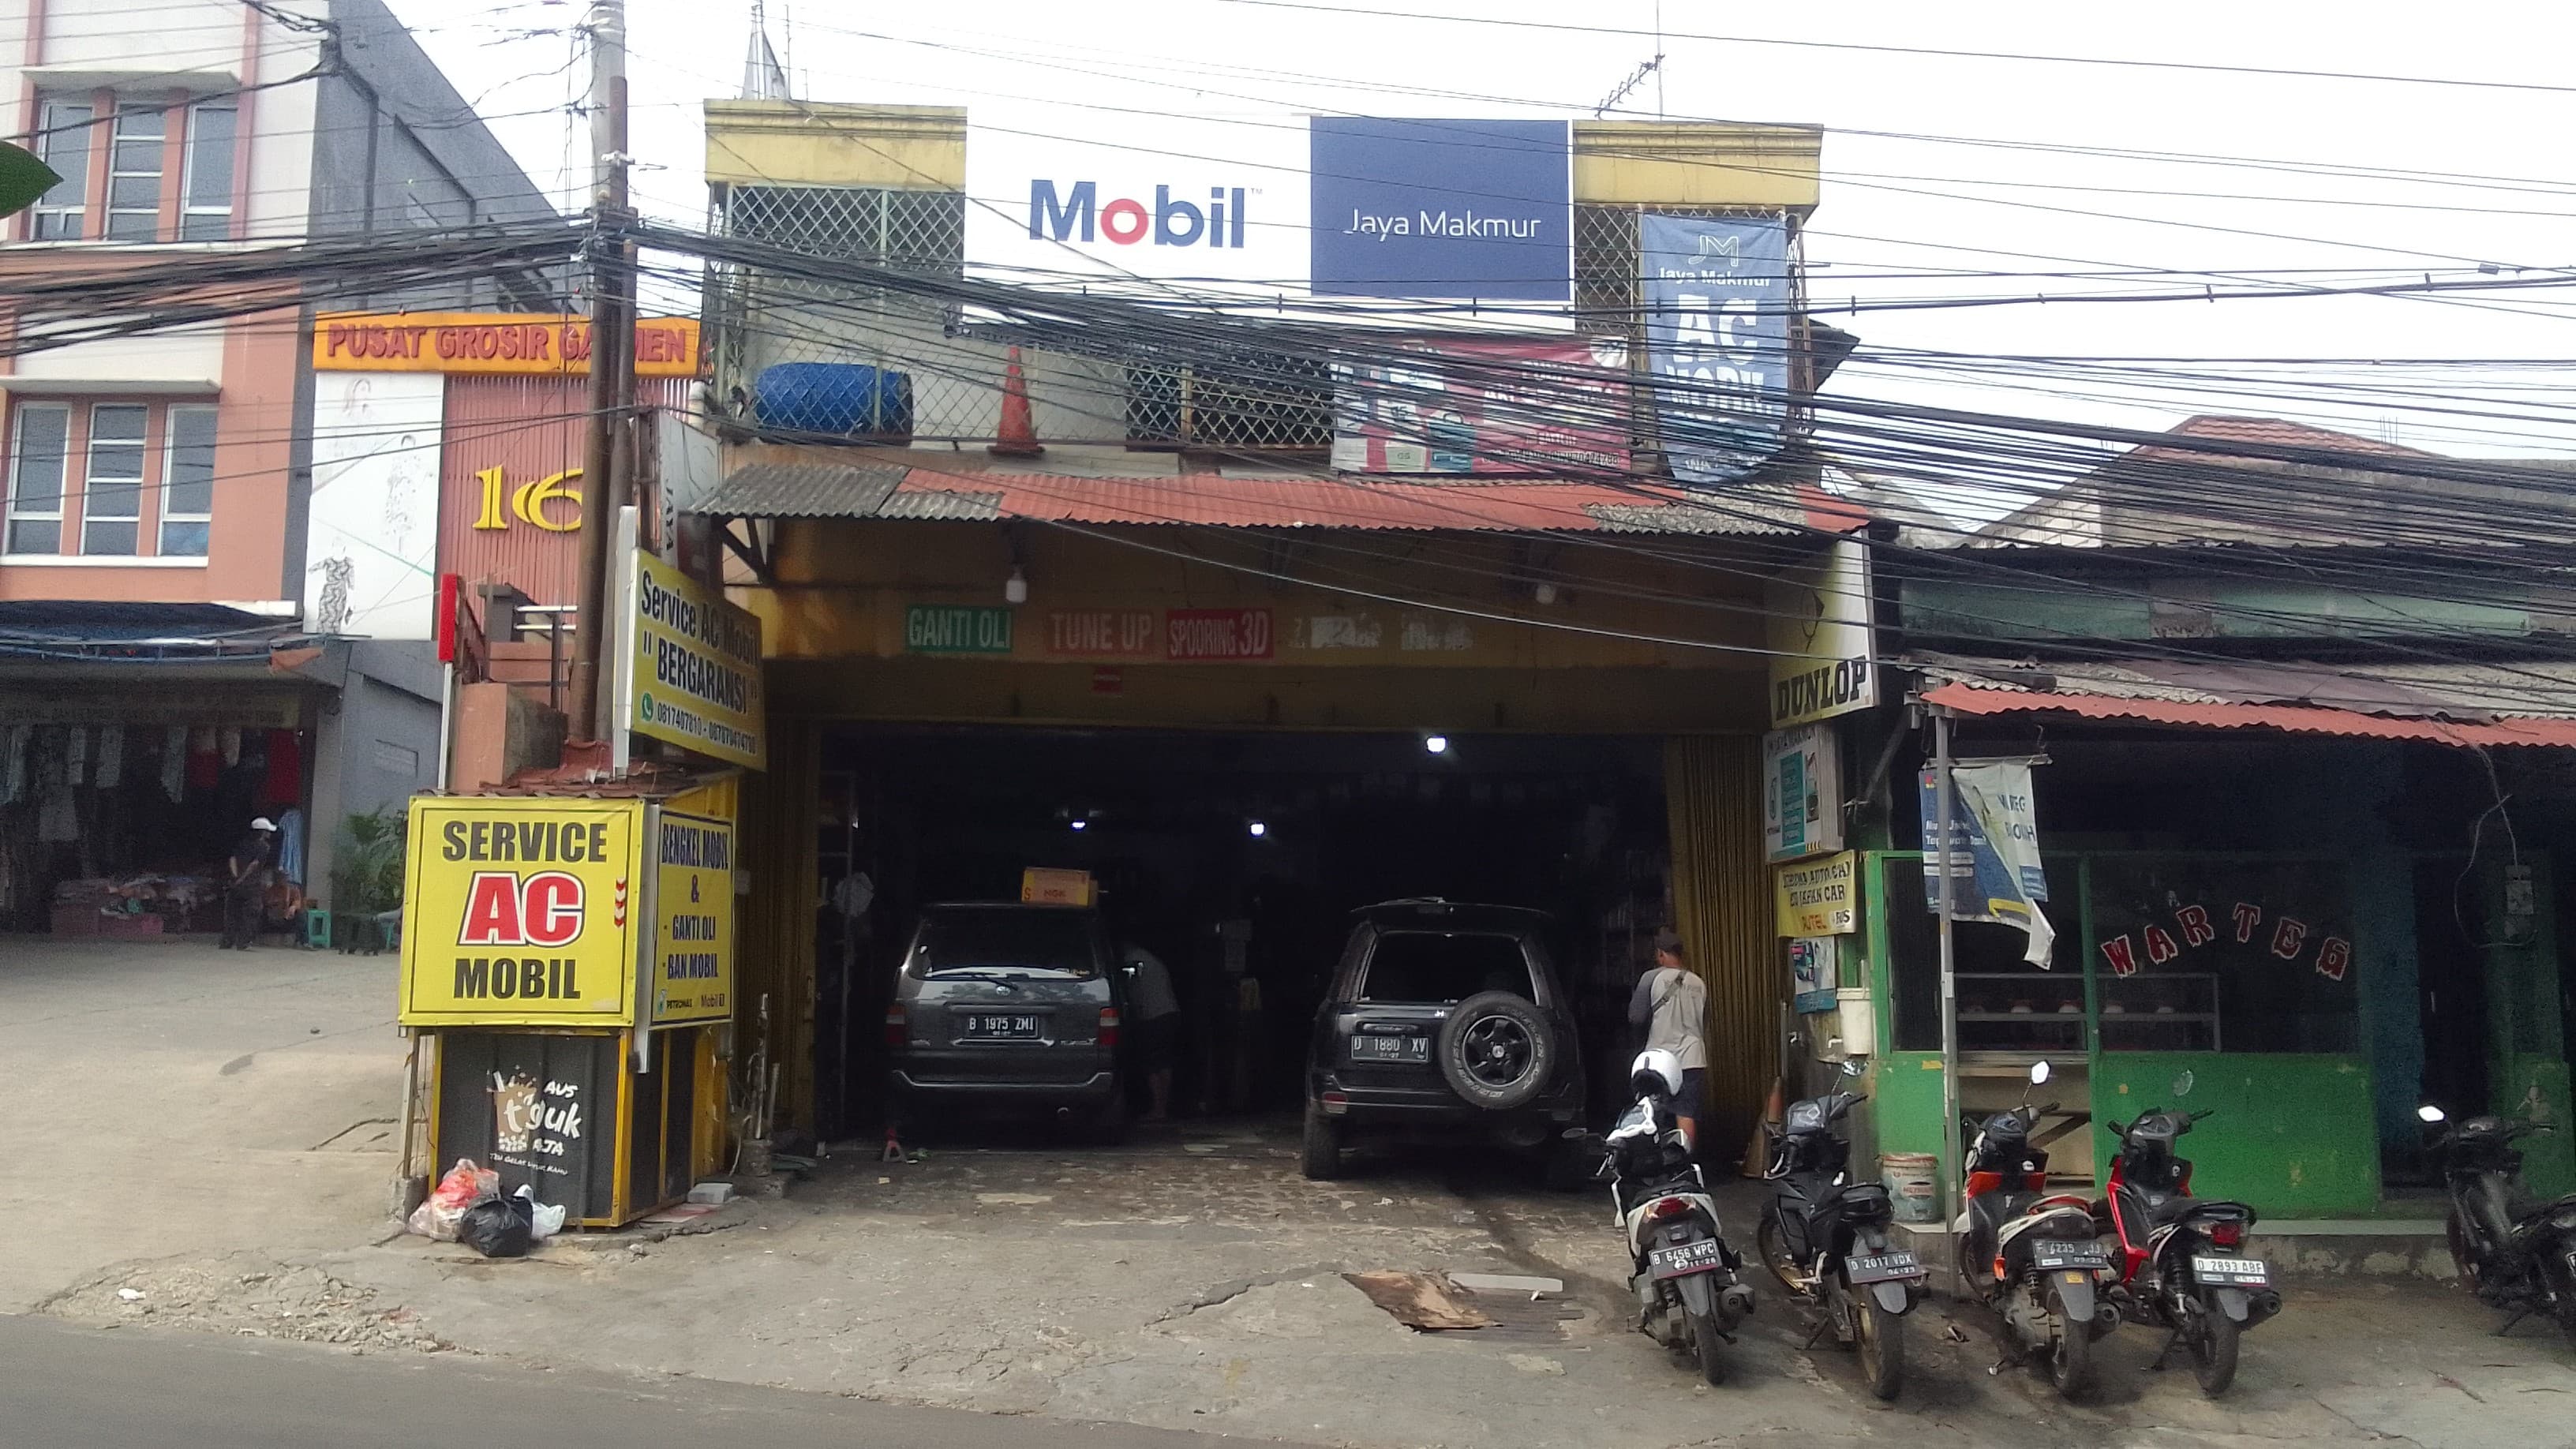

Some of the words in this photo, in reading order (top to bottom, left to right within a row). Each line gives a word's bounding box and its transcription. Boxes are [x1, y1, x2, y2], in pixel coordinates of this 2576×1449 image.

[1028, 179, 1245, 249] Mobil
[1343, 207, 1410, 243] Jaya
[1419, 209, 1541, 238] Makmur
[1688, 235, 1739, 267] JM
[327, 324, 428, 360] PUSAT
[435, 325, 550, 361] GROSIR
[558, 326, 686, 363] GAEN
[1672, 294, 1758, 365] AC
[641, 570, 696, 637] Service
[701, 602, 720, 649] AC
[723, 615, 758, 667] Mobil
[908, 608, 971, 649] GANTI
[978, 608, 1011, 649] OLI
[1050, 613, 1114, 650] TUNE
[1121, 613, 1152, 650] UP
[1170, 619, 1237, 658] SPOORING
[1238, 612, 1271, 657] 3D
[657, 637, 748, 714] BERGARANSI
[1777, 654, 1866, 721] DUNLOP
[442, 820, 608, 863] SERVICE
[661, 823, 701, 867] BENGKEL
[702, 829, 729, 871] MOBIL
[691, 874, 700, 903] &
[1825, 884, 1845, 902] CAR
[456, 870, 586, 947] AC
[672, 914, 699, 941] GANTI
[702, 915, 716, 941] OLI
[2100, 901, 2351, 981] WARTEG
[453, 957, 582, 1000] MOBIL
[668, 953, 687, 980] BAN
[689, 952, 719, 979] MOBIL
[969, 1018, 977, 1032] B
[985, 1017, 1009, 1032] 1975
[1354, 1038, 1362, 1050] D
[1374, 1038, 1401, 1052] 1880
[1411, 1038, 1426, 1053] XV
[544, 1080, 579, 1099] AUS
[533, 1137, 564, 1156] AJA
[1653, 1254, 1661, 1265] B
[1665, 1248, 1691, 1263] 6456
[1693, 1243, 1714, 1256] WPC
[1863, 1256, 1889, 1269] 2017
[1893, 1253, 1913, 1265] VDX
[2198, 1260, 2204, 1270] D
[2211, 1261, 2237, 1272] 2893
[2242, 1261, 2262, 1274] ABF
